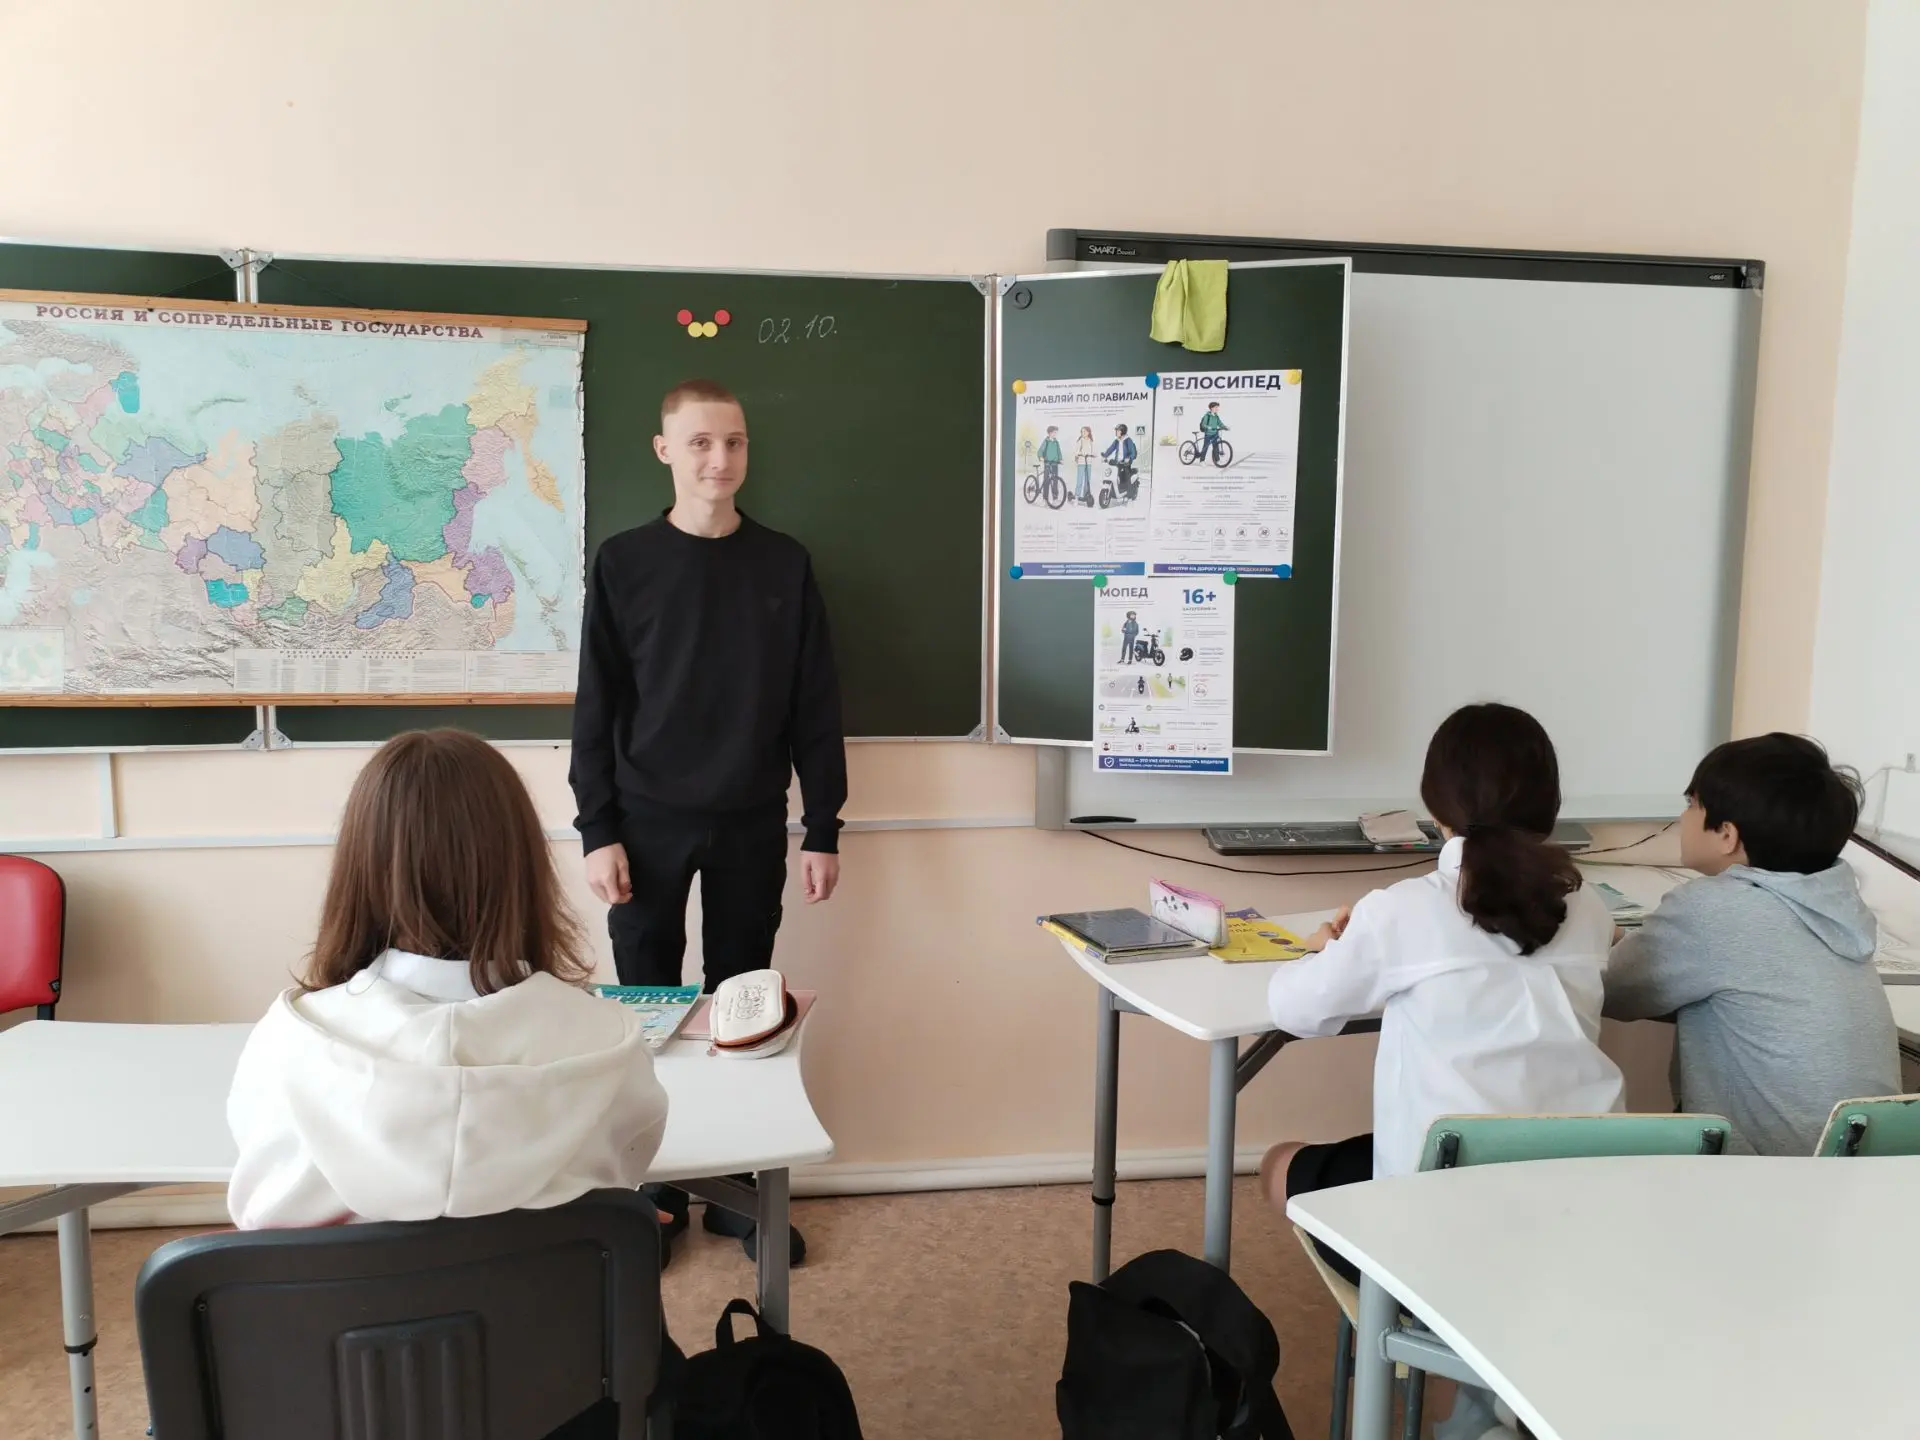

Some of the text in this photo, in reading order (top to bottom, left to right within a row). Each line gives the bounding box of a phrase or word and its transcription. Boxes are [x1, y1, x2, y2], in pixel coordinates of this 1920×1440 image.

[1088, 245, 1117, 254] SMART
[36, 305, 483, 339] РОССИЯ И СОПРЕДЕЛЬНЫЕ ГОСУДАРСТВА
[1162, 374, 1281, 391] ВЕЛОСИПЕД
[1023, 392, 1149, 405] УПРАВЛЯЙ ПО ПРАВИЛАМ
[1099, 587, 1148, 598] МОПЕД
[1182, 588, 1216, 604] 16+
